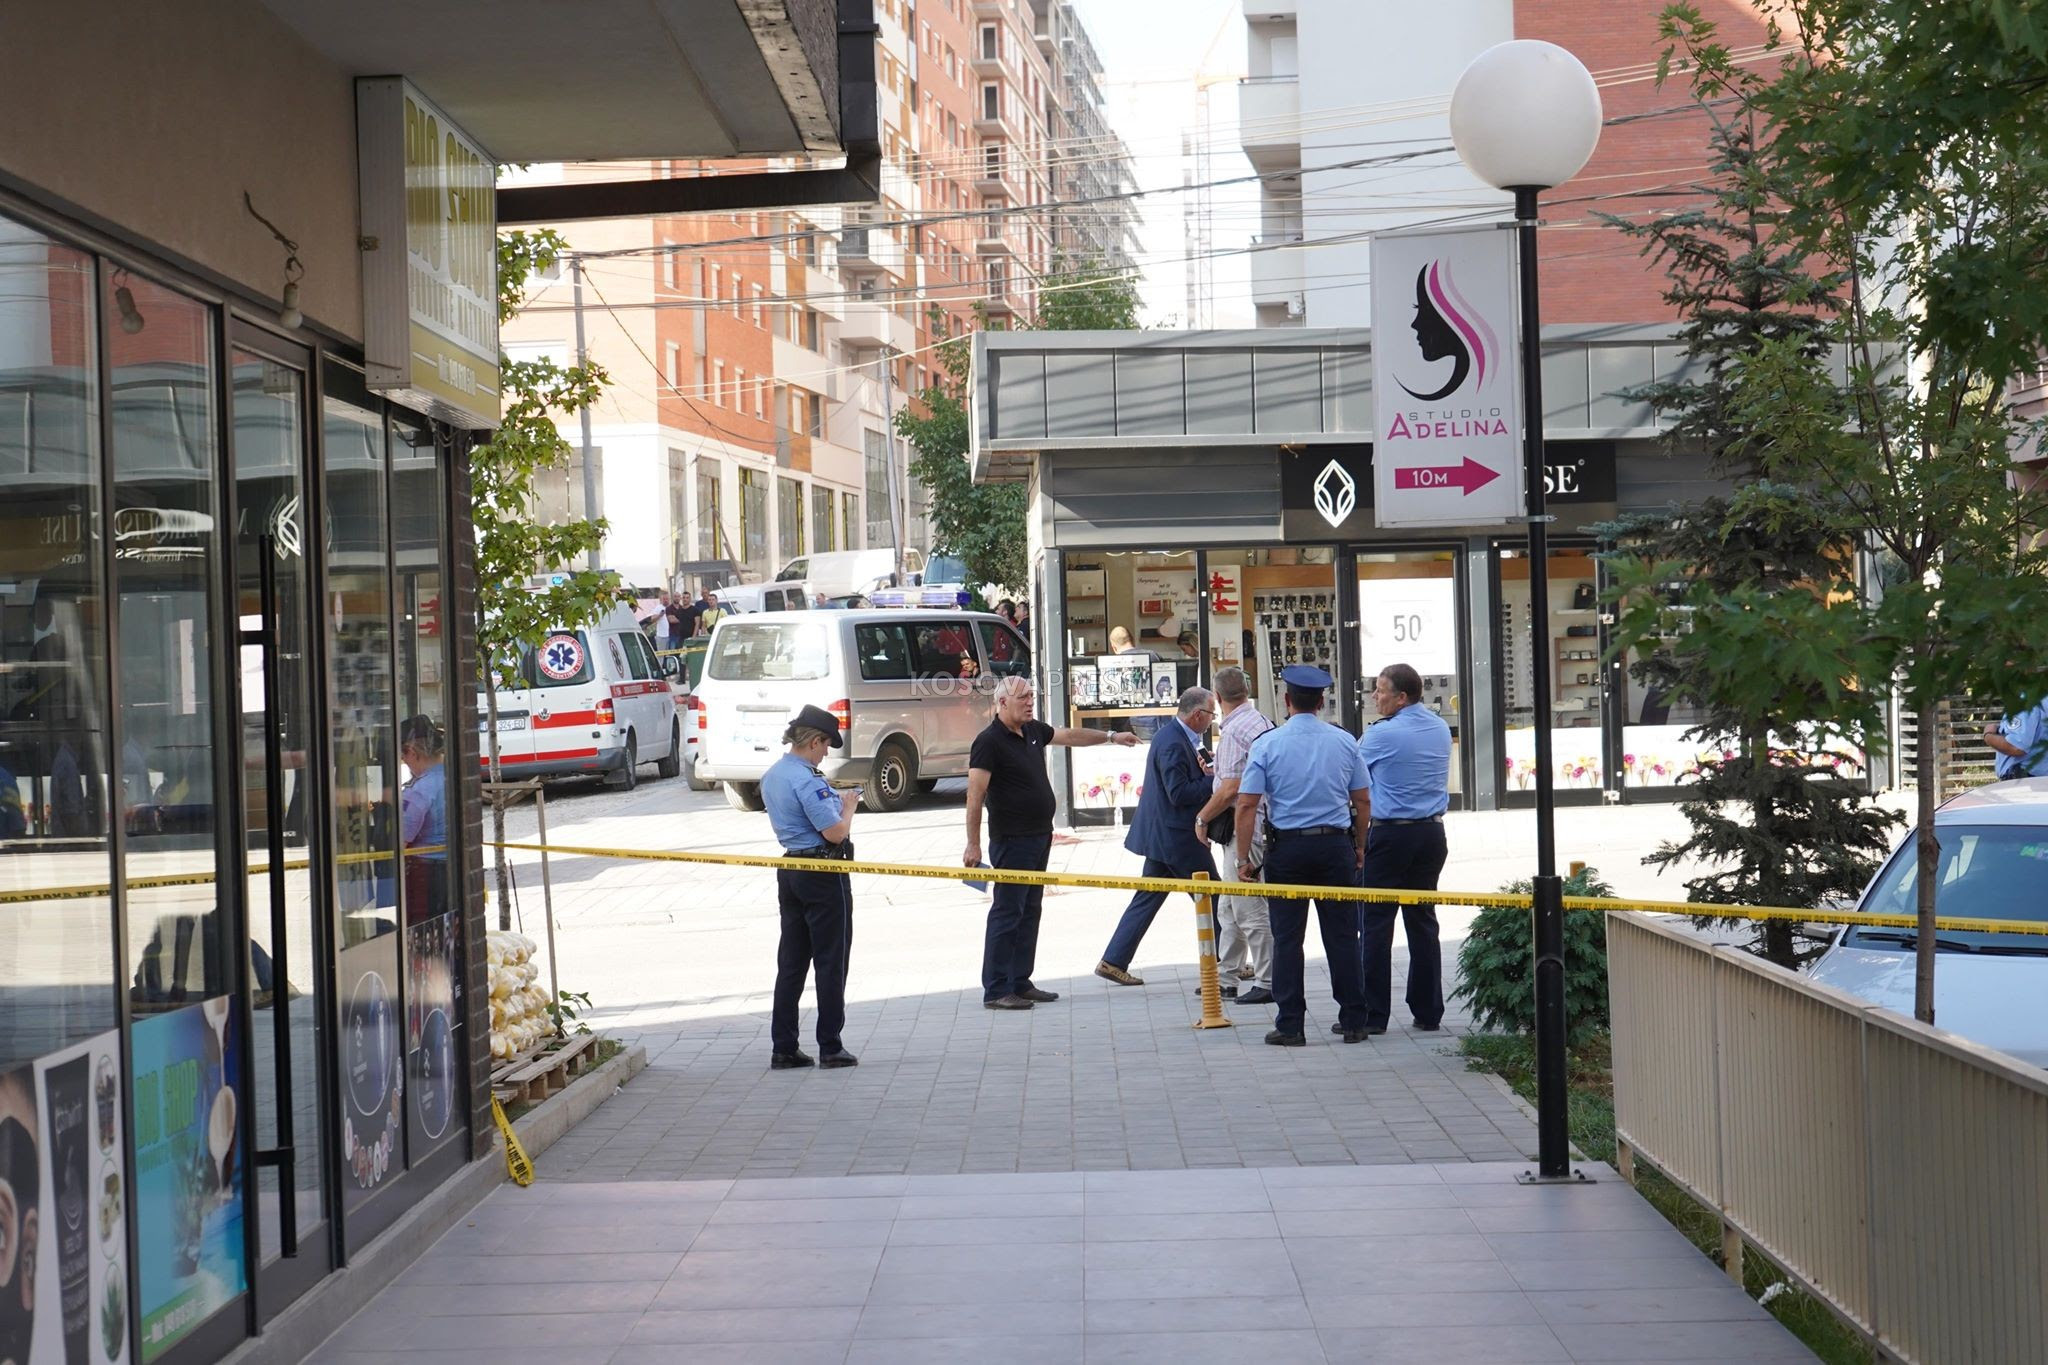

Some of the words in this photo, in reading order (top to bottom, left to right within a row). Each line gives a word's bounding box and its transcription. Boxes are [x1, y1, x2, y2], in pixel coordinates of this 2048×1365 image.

[446, 132, 493, 301] SHOP
[1387, 412, 1509, 441] ADELINA
[1409, 407, 1501, 421] STUDIO
[1393, 614, 1422, 642] 50
[163, 1058, 198, 1135] SHOP
